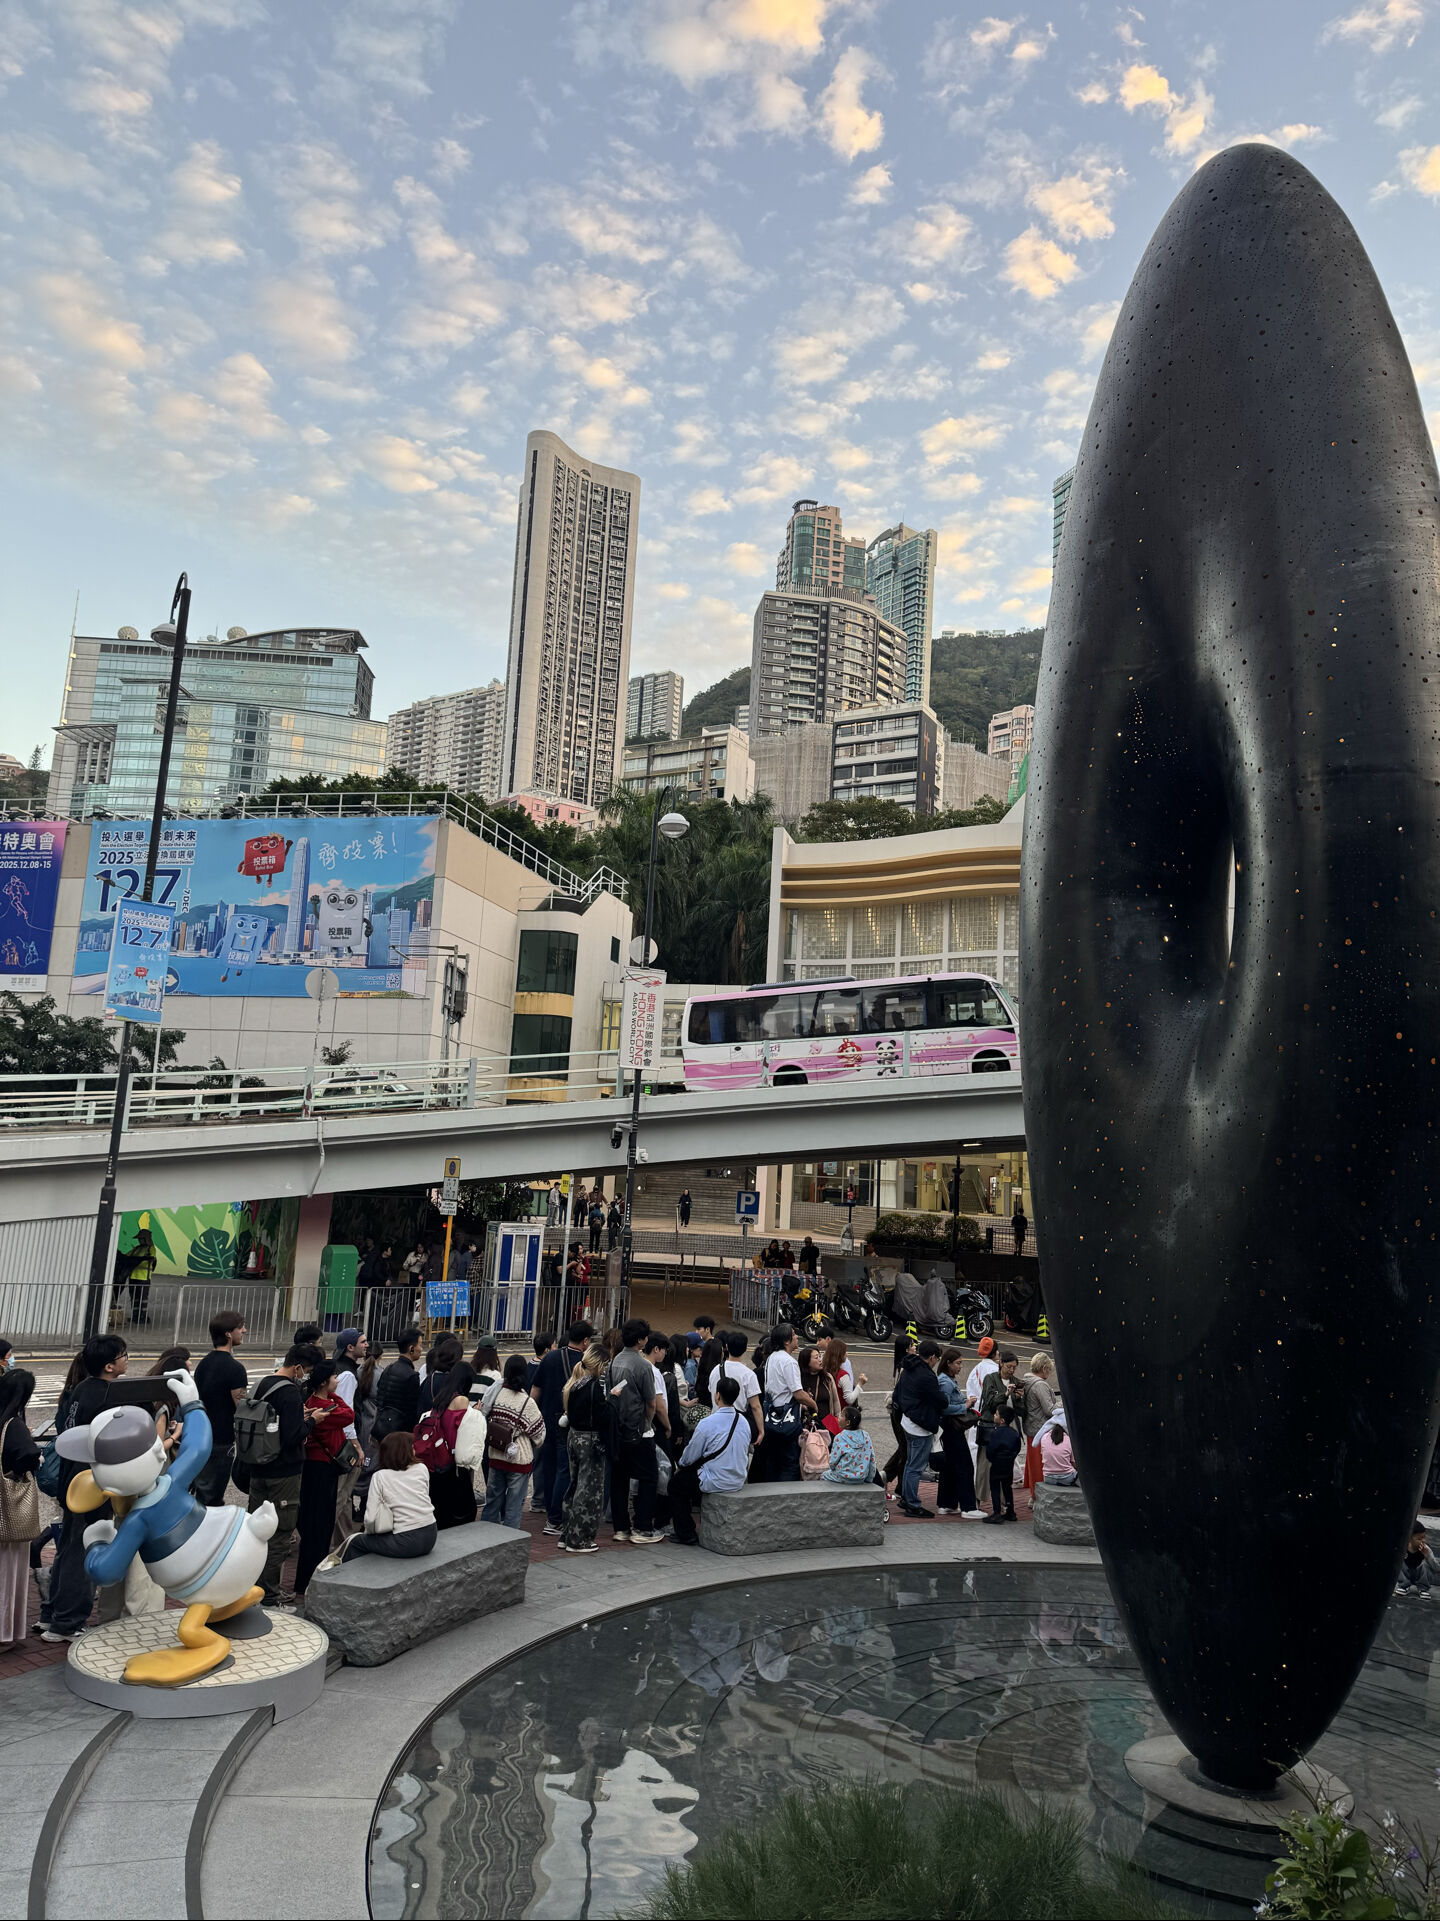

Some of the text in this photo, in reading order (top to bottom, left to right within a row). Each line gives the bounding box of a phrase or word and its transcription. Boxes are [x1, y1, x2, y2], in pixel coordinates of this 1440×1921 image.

[0, 832, 55, 850] 特奧會
[101, 830, 197, 842] 投入選舉 創未來
[98, 851, 134, 865] 2025
[253, 855, 276, 866] 投票箱
[181, 895, 190, 912] DEC
[122, 917, 140, 926] 2025
[328, 927, 352, 936] 投票箱
[634, 992, 647, 1066] HONG KONG
[740, 1193, 756, 1212] P
